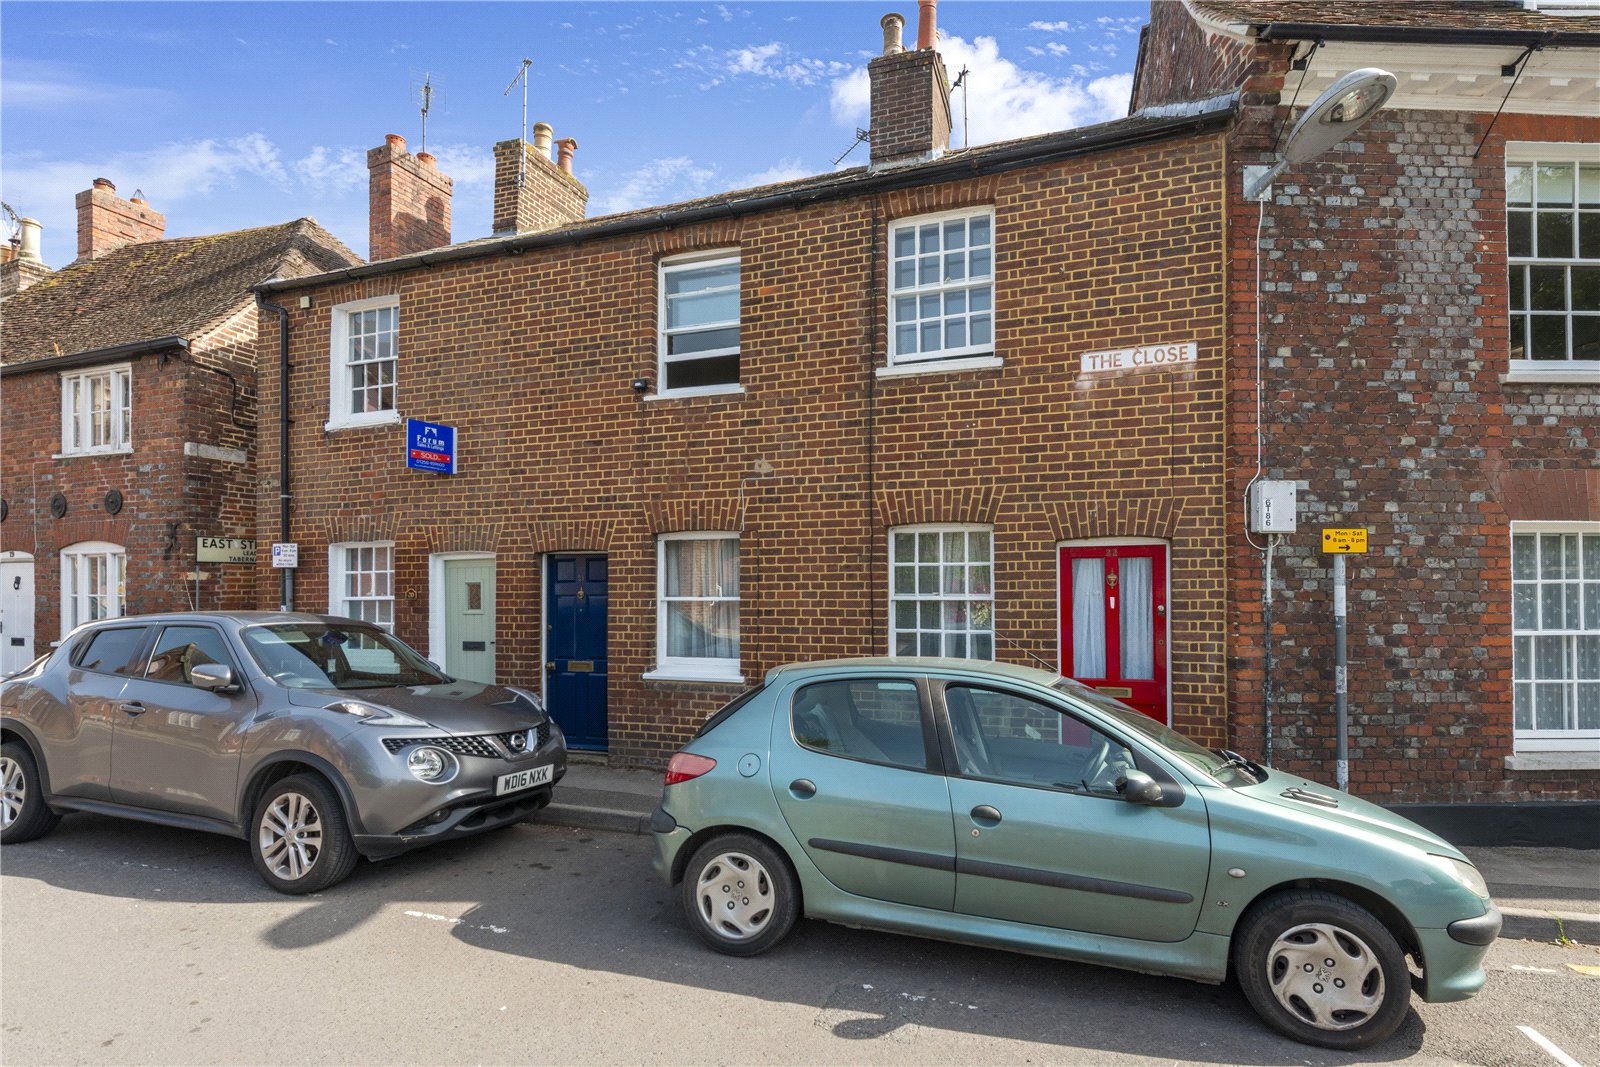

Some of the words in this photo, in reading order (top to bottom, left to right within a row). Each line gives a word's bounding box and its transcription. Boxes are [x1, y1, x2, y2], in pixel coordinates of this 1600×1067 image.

[1088, 352, 1122, 370] THE
[1132, 345, 1189, 366] CLOSE
[416, 434, 445, 447] Forum
[420, 452, 439, 461] SOLD
[202, 538, 233, 549] EAST
[503, 772, 527, 791] WD16
[528, 767, 548, 785] NXK
